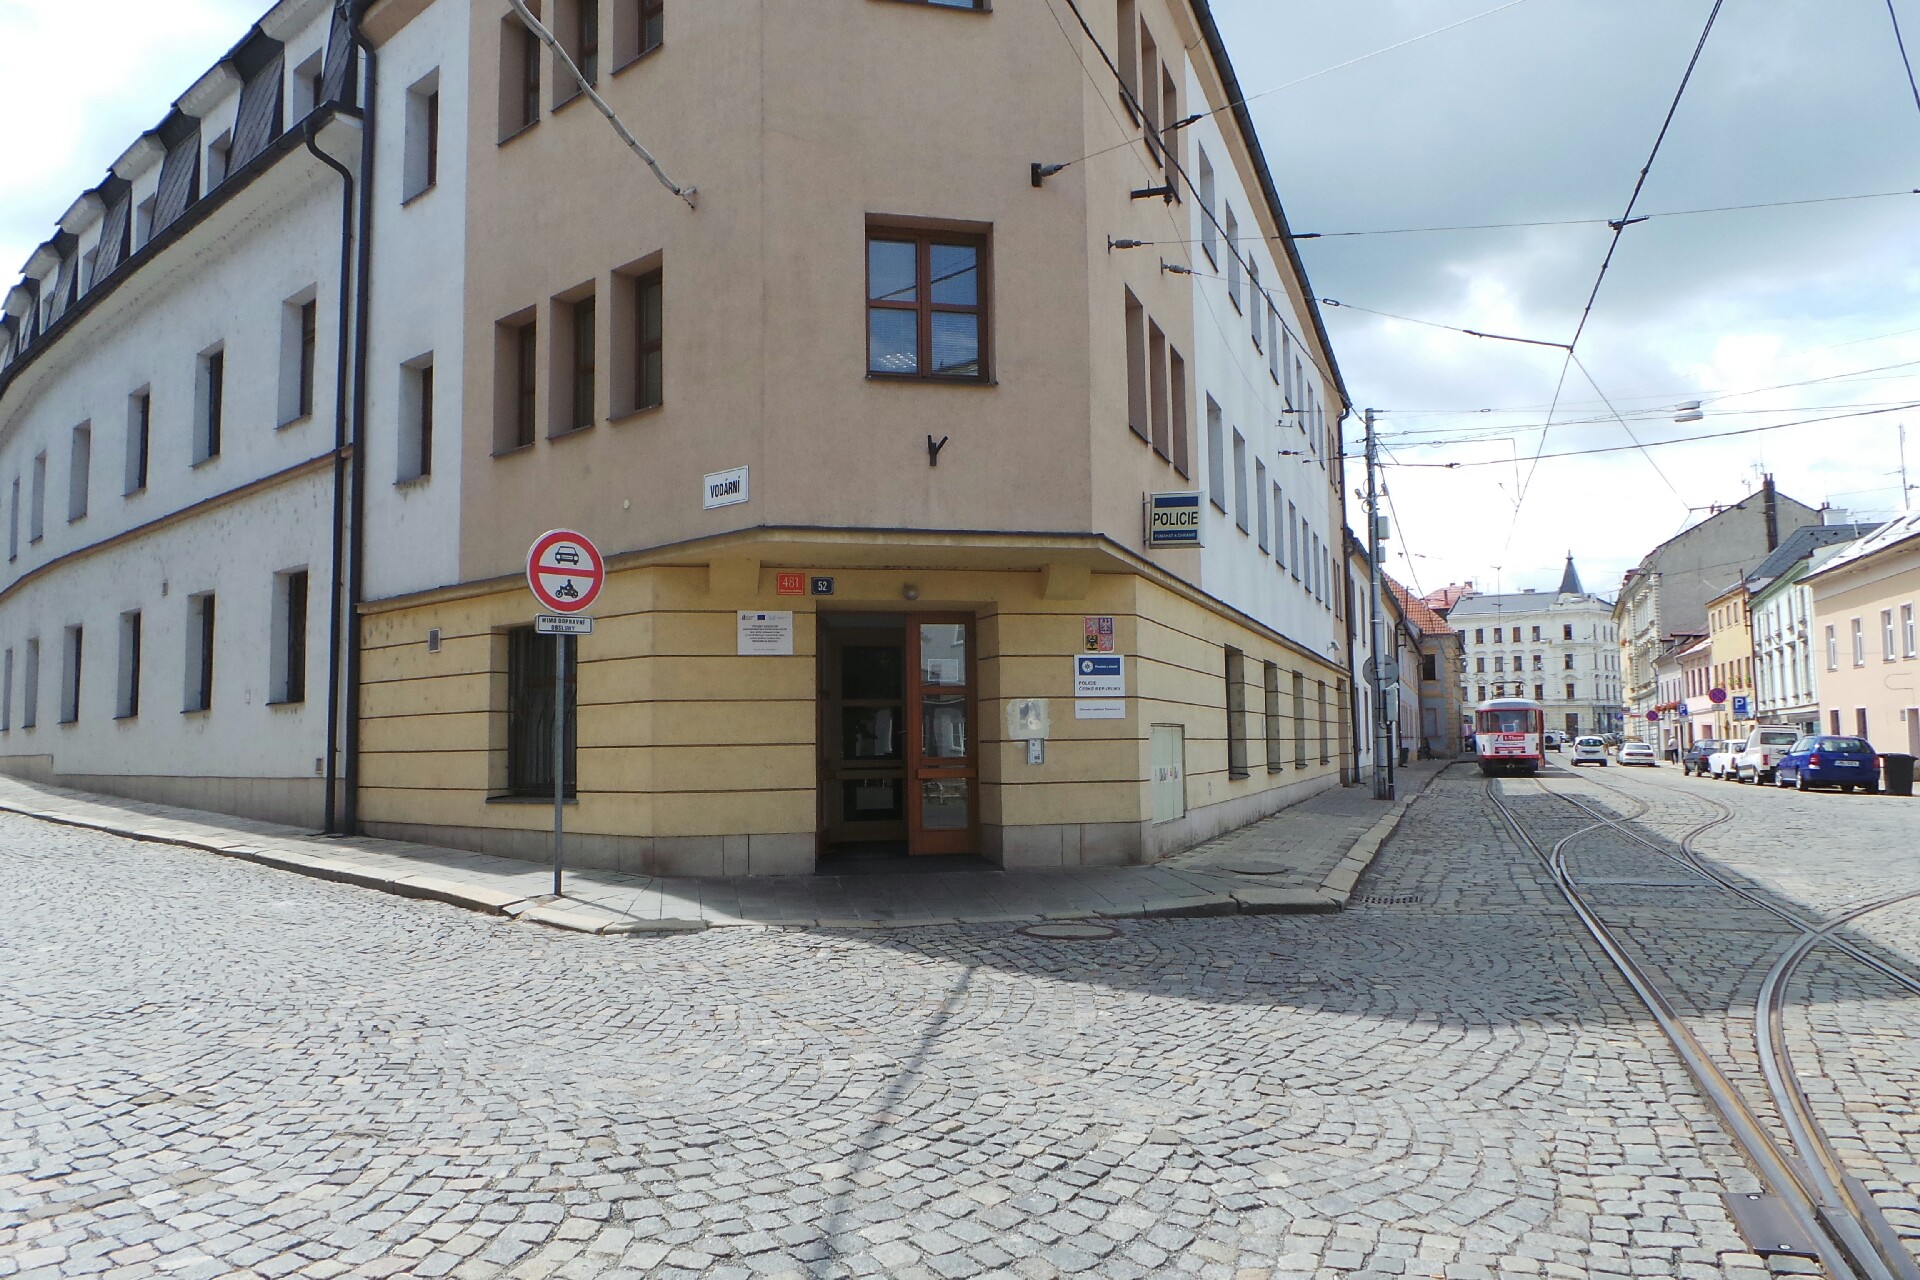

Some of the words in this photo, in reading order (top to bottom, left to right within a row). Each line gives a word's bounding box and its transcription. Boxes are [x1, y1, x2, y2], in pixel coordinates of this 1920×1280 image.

[710, 475, 741, 498] VODÁRNÍ
[1153, 511, 1198, 526] POLICIE
[782, 576, 800, 588] 481
[817, 580, 828, 591] 52
[1735, 698, 1744, 709] P
